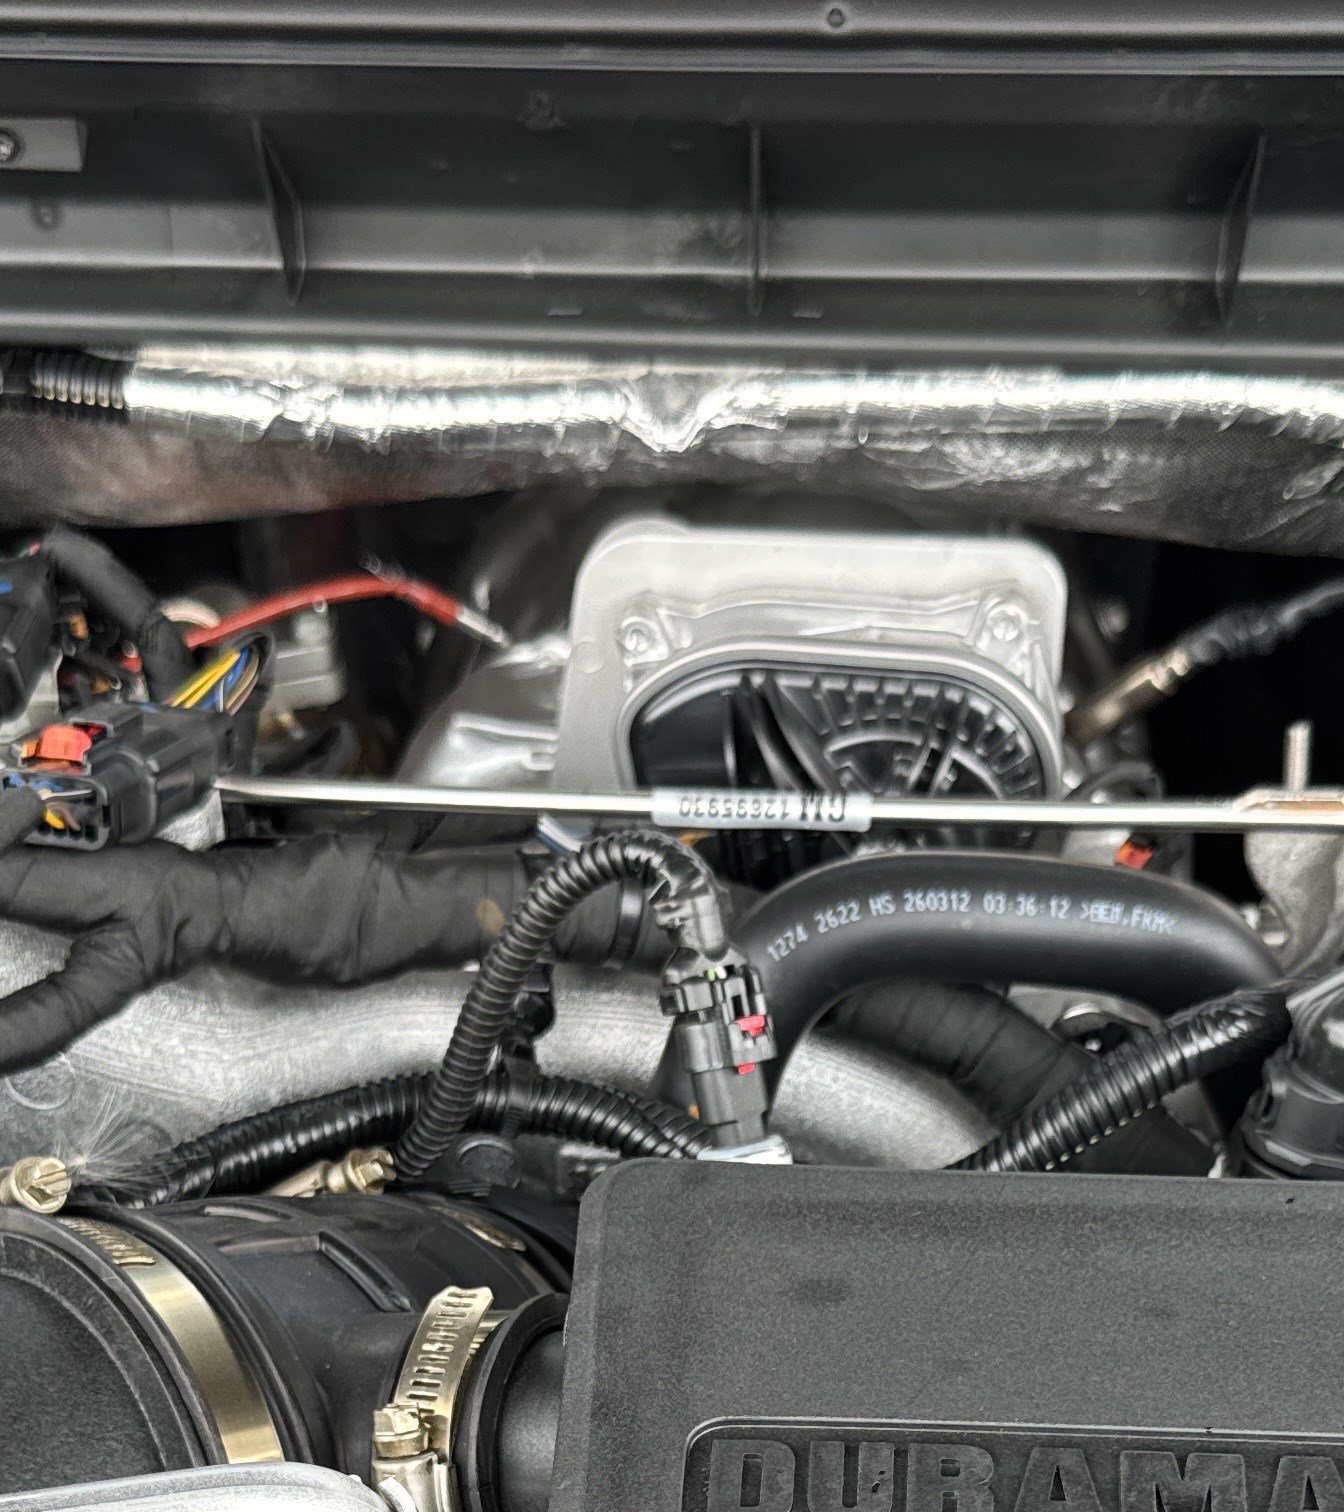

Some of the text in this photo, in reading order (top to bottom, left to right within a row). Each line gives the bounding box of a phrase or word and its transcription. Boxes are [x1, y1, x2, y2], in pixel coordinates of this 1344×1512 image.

[814, 899, 862, 933] 2622
[868, 892, 896, 916] HS
[904, 890, 972, 913] 260312
